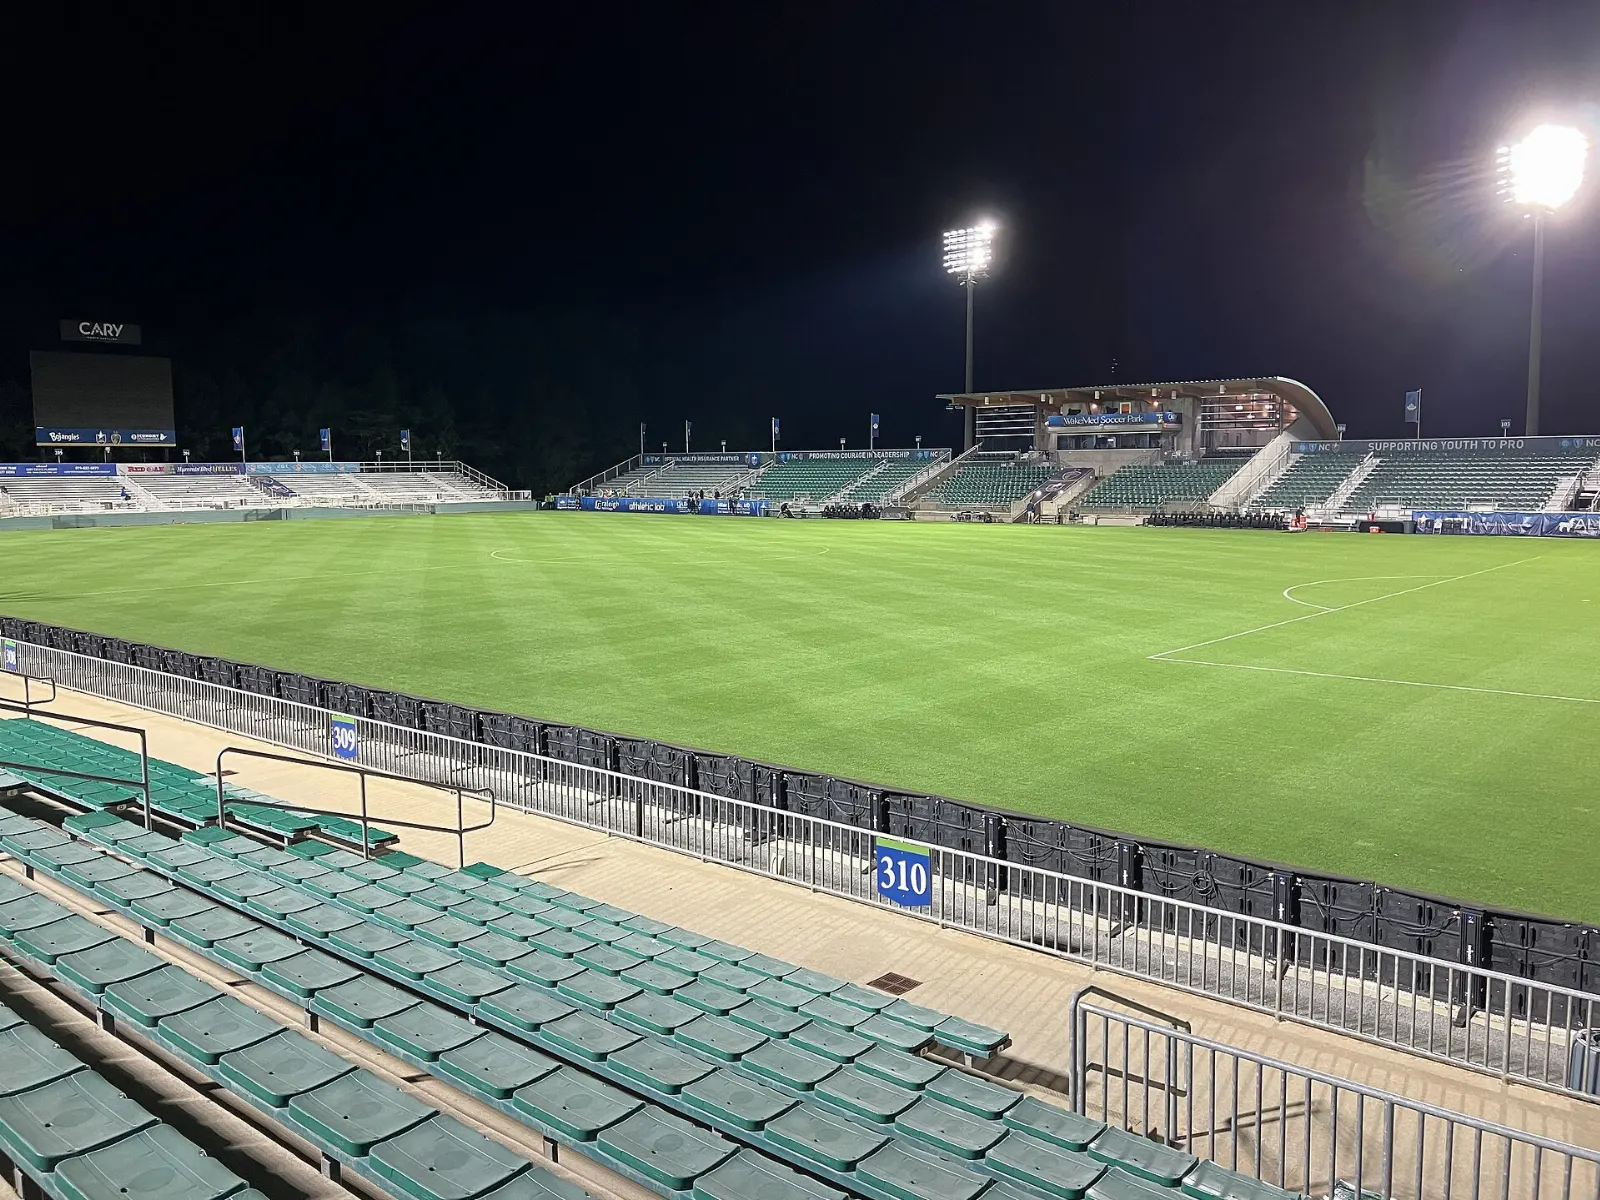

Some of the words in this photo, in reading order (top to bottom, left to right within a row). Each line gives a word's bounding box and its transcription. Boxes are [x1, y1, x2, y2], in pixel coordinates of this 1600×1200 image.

[79, 322, 123, 337] CARY
[1063, 417, 1099, 425] WakeMed
[1100, 416, 1126, 424] Soccer
[1127, 414, 1143, 423] Park
[49, 432, 80, 442] Bojangles
[1368, 441, 1438, 451] SUPPORTING
[1440, 440, 1478, 450] YOUTH
[1481, 440, 1496, 449] TO
[1500, 439, 1525, 449] PRO
[874, 451, 910, 459] LEADERSHIP
[628, 502, 654, 511] athletic
[333, 726, 355, 752] 309
[880, 856, 927, 895] 310
